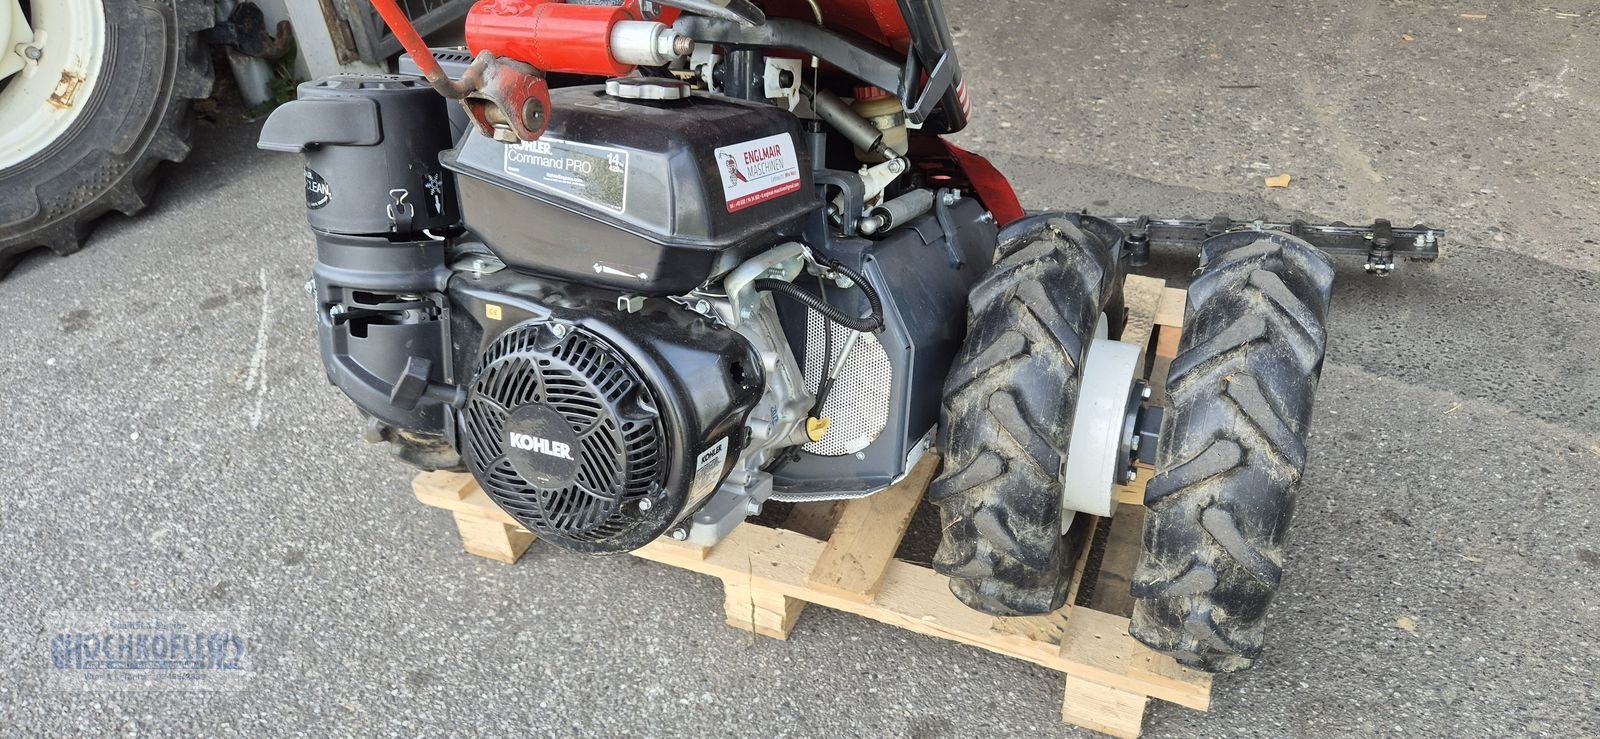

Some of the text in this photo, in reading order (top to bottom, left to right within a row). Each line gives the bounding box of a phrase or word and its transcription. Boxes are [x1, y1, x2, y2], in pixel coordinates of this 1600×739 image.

[508, 149, 592, 174] Command PRO
[607, 152, 619, 166] 14
[744, 144, 782, 165] ENGLMAIR
[747, 158, 785, 178] MASCHINEN
